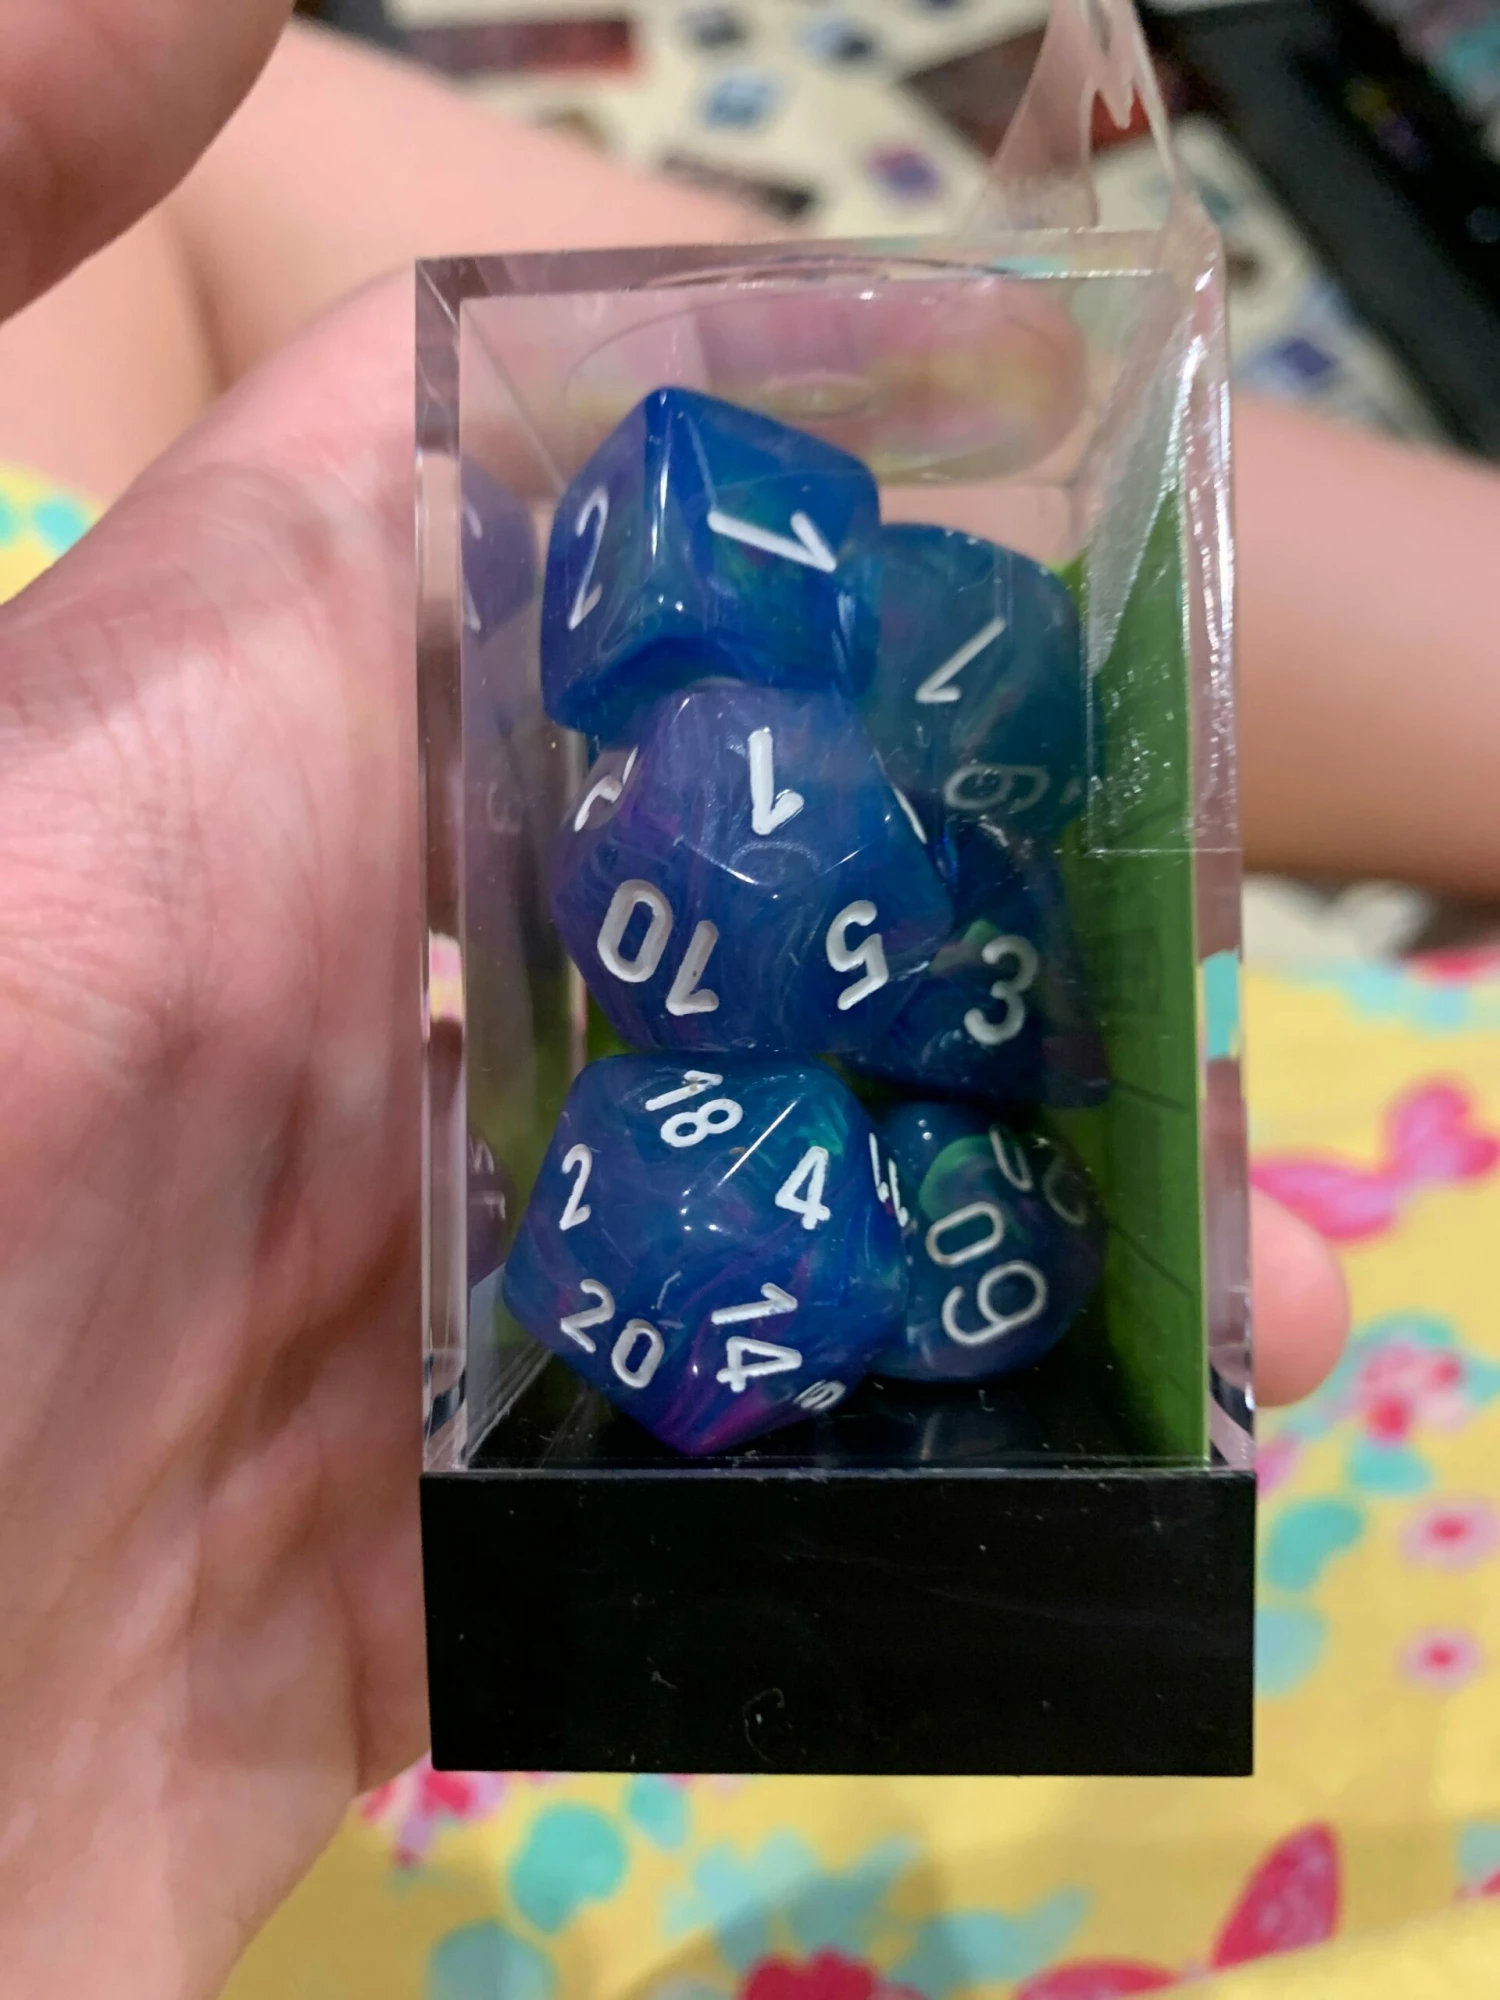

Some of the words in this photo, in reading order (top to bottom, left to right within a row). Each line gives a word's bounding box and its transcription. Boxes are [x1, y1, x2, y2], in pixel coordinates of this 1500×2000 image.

[567, 485, 608, 629] 2
[707, 511, 837, 573] 1
[747, 727, 805, 835] 1
[596, 878, 720, 1016] 10
[825, 899, 889, 1011] 5
[963, 934, 1039, 1046] 3
[645, 1069, 744, 1148] 18
[560, 1143, 593, 1231] 2
[774, 1146, 831, 1230] 4
[560, 1278, 665, 1389] 20
[711, 1282, 803, 1393] 14
